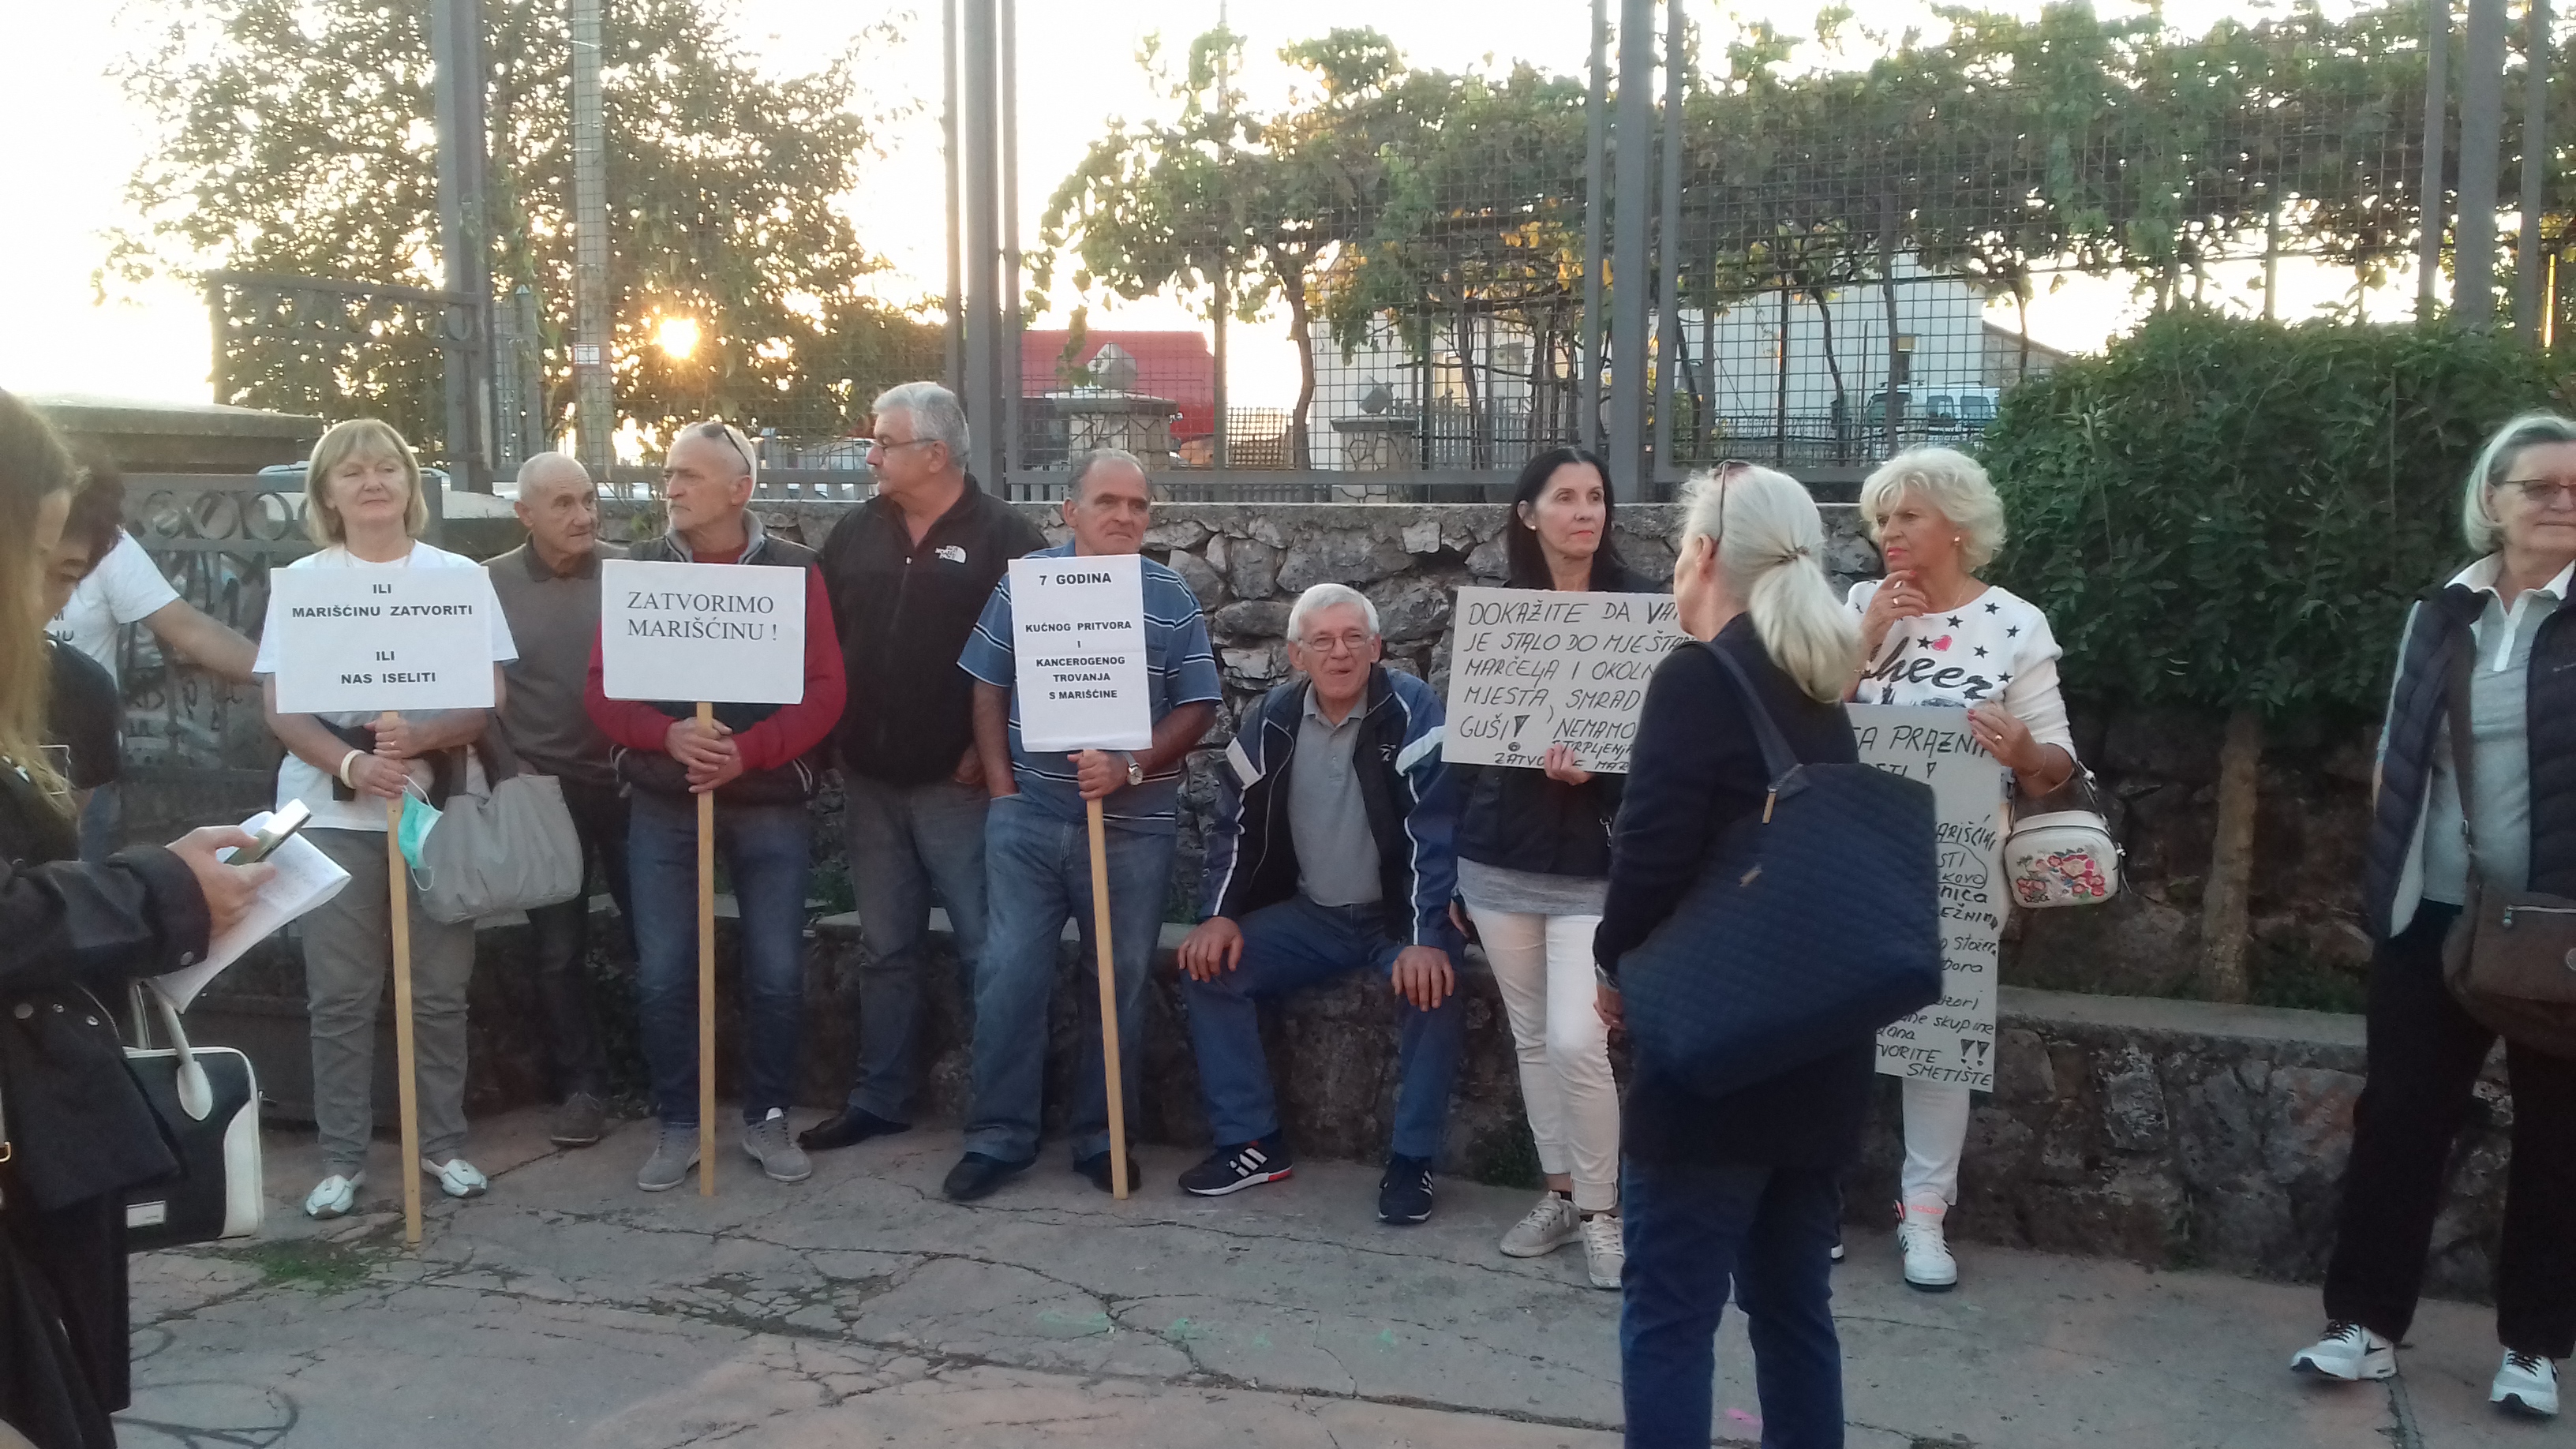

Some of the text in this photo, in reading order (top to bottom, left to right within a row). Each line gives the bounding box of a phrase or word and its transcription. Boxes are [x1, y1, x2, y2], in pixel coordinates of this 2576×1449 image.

[1039, 573, 1112, 586] 7 GODINA
[373, 584, 392, 594] ILI
[627, 592, 774, 614] ZATVORIMO
[292, 605, 474, 618] MARIŠĆINU ZATVORITI
[1468, 600, 1679, 625] DOKAŽITE DA VA
[627, 617, 765, 641] MARIŠĆINU
[1025, 621, 1133, 633] KUĆNOG PRITVORA
[1463, 632, 1492, 652] JE
[1501, 632, 1561, 653] STALO
[1566, 634, 1597, 652] DO
[376, 651, 395, 661] ILI
[1036, 657, 1126, 668] KANCEROGENOG
[1571, 661, 1580, 680] I
[341, 672, 436, 684] NAS ISELITI
[1053, 674, 1111, 683] TROVANJA
[1049, 689, 1118, 700] S MARIŠĆINE
[1565, 689, 1641, 711] SMRAD
[1552, 717, 1636, 739] NEMAMO
[1907, 1063, 1993, 1086] SMETIŠTE
